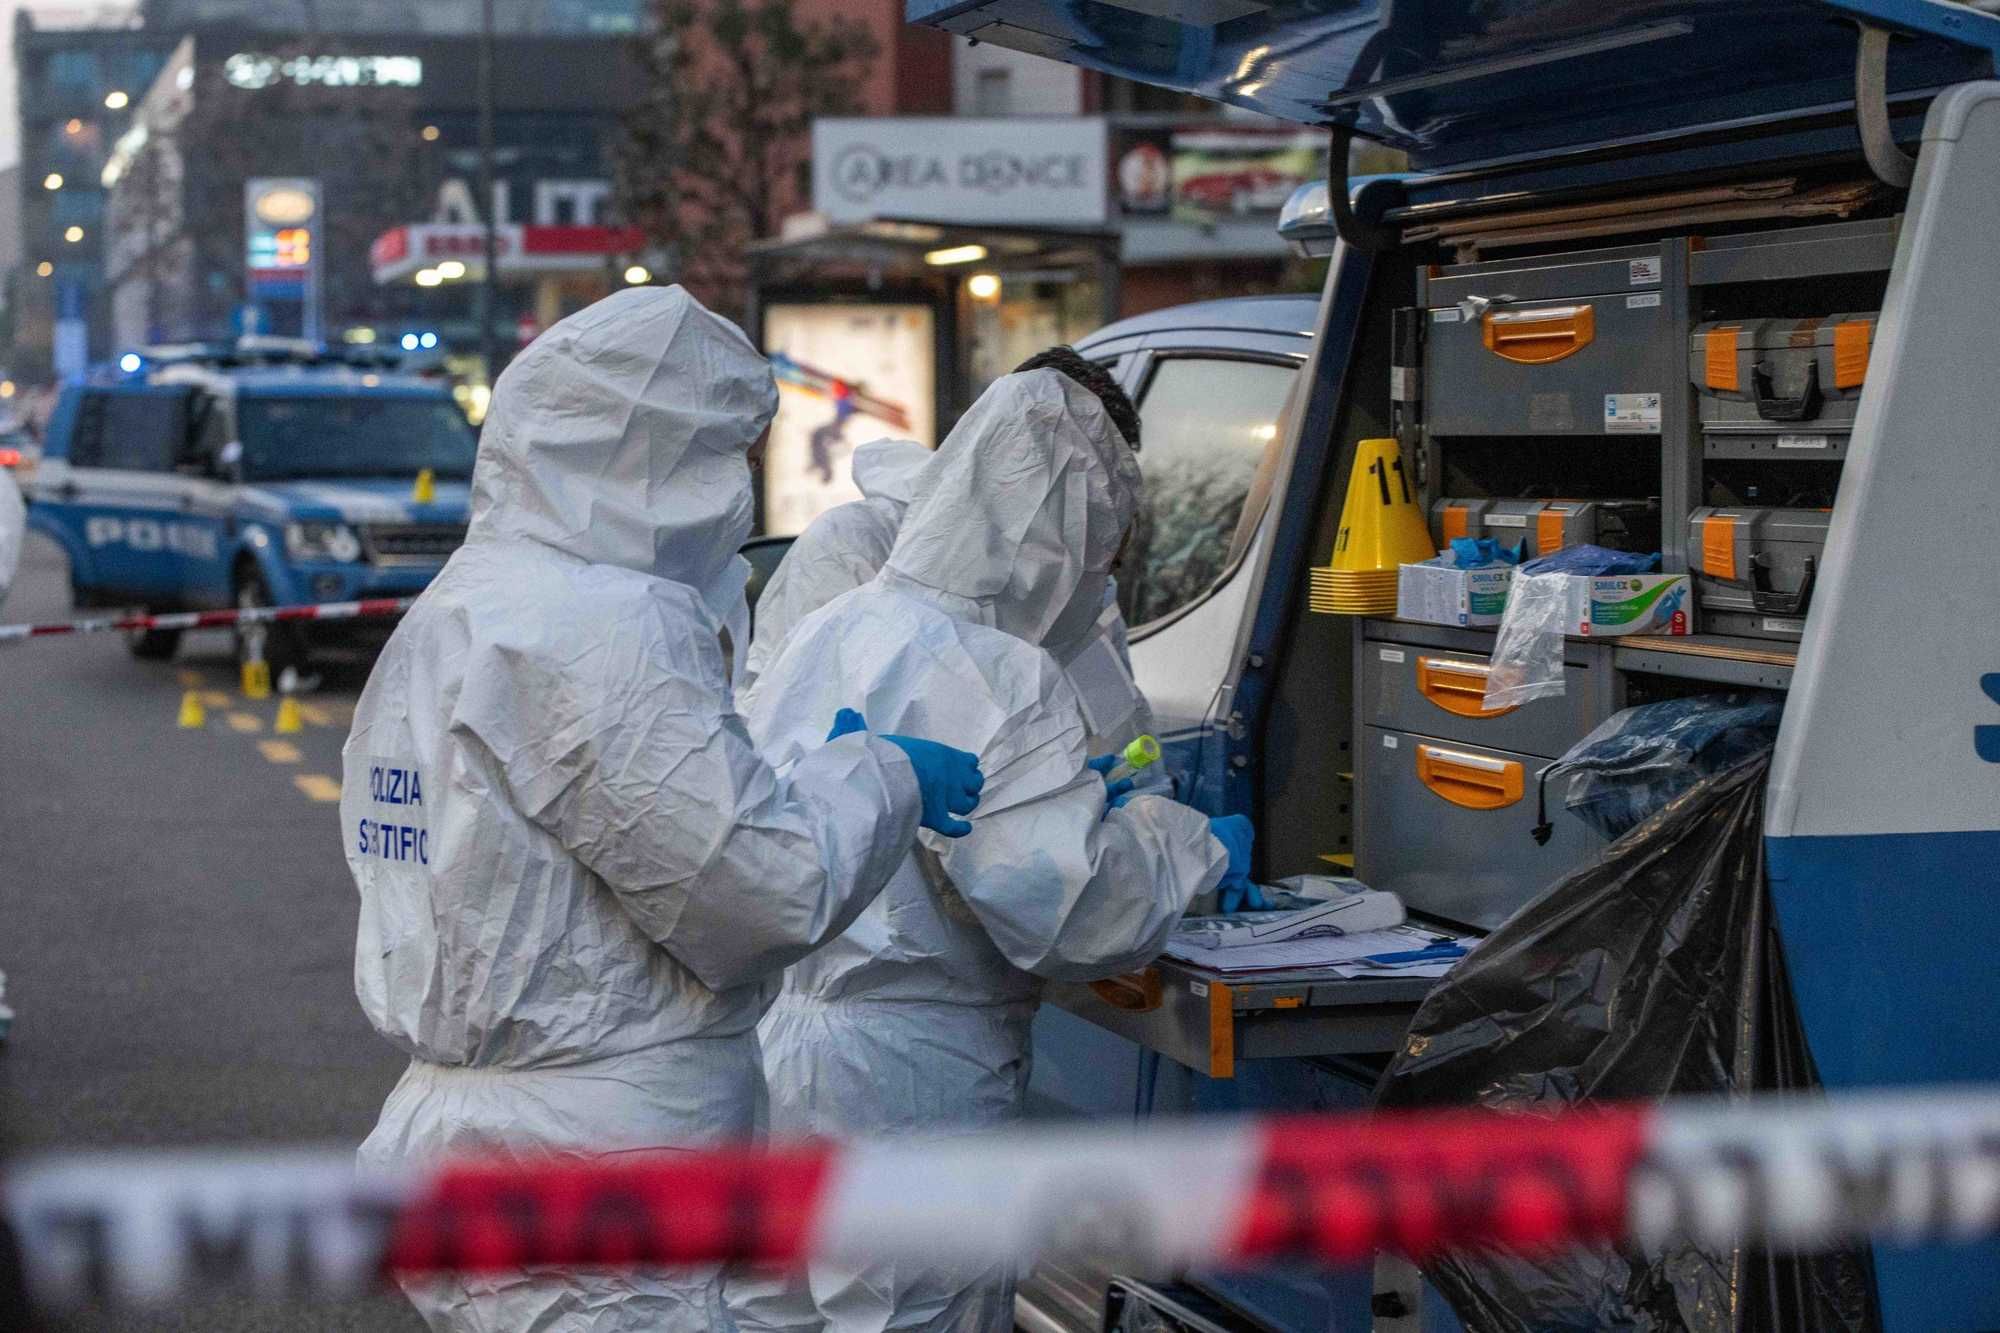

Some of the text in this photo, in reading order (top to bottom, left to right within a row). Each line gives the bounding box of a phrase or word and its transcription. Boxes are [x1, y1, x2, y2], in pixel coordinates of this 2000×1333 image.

[1369, 456, 1412, 505] 11
[1674, 613, 1684, 623] S
[369, 766, 422, 806] OLIZIA
